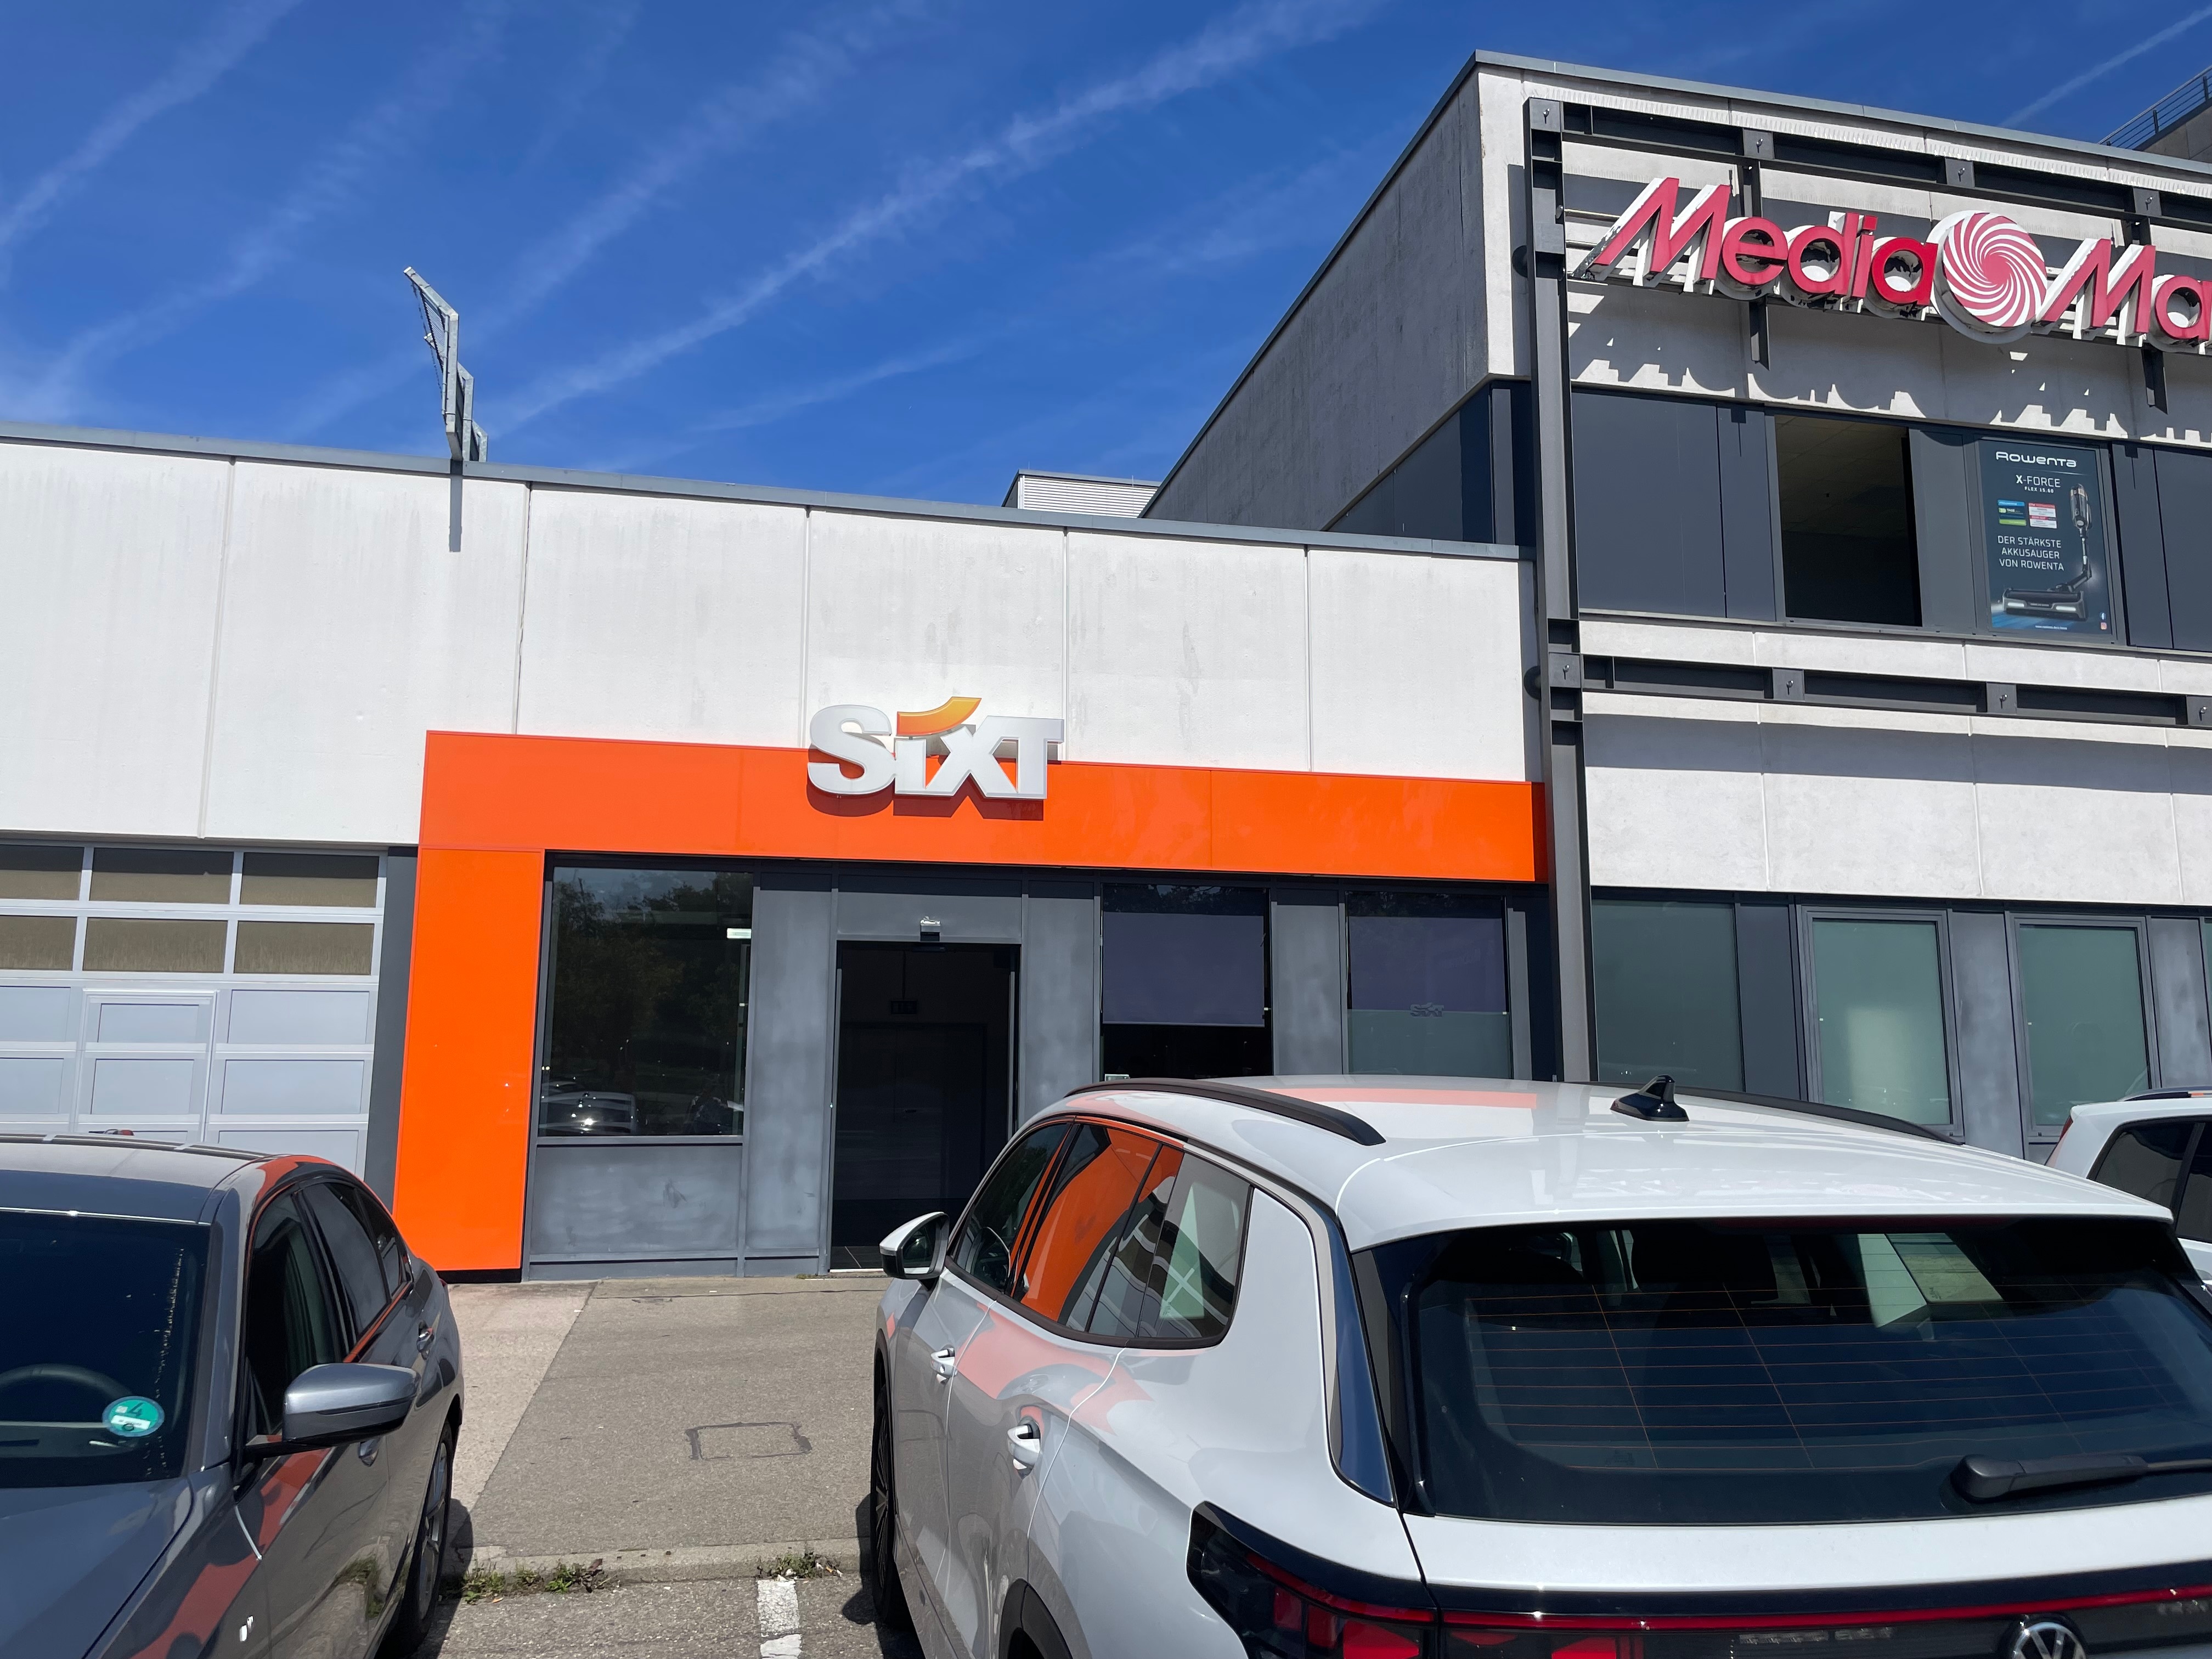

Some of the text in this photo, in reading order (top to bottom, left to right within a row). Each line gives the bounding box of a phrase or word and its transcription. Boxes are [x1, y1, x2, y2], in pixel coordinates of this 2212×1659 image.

[1578, 177, 1939, 310] Media
[2016, 475, 2061, 488] X-FORCE
[1997, 535, 2062, 548] DER STÄRKSTE
[2001, 547, 2060, 559] AKKUSAUGER
[1999, 558, 2064, 571] VON ROWENTA
[129, 1402, 144, 1417] 4
